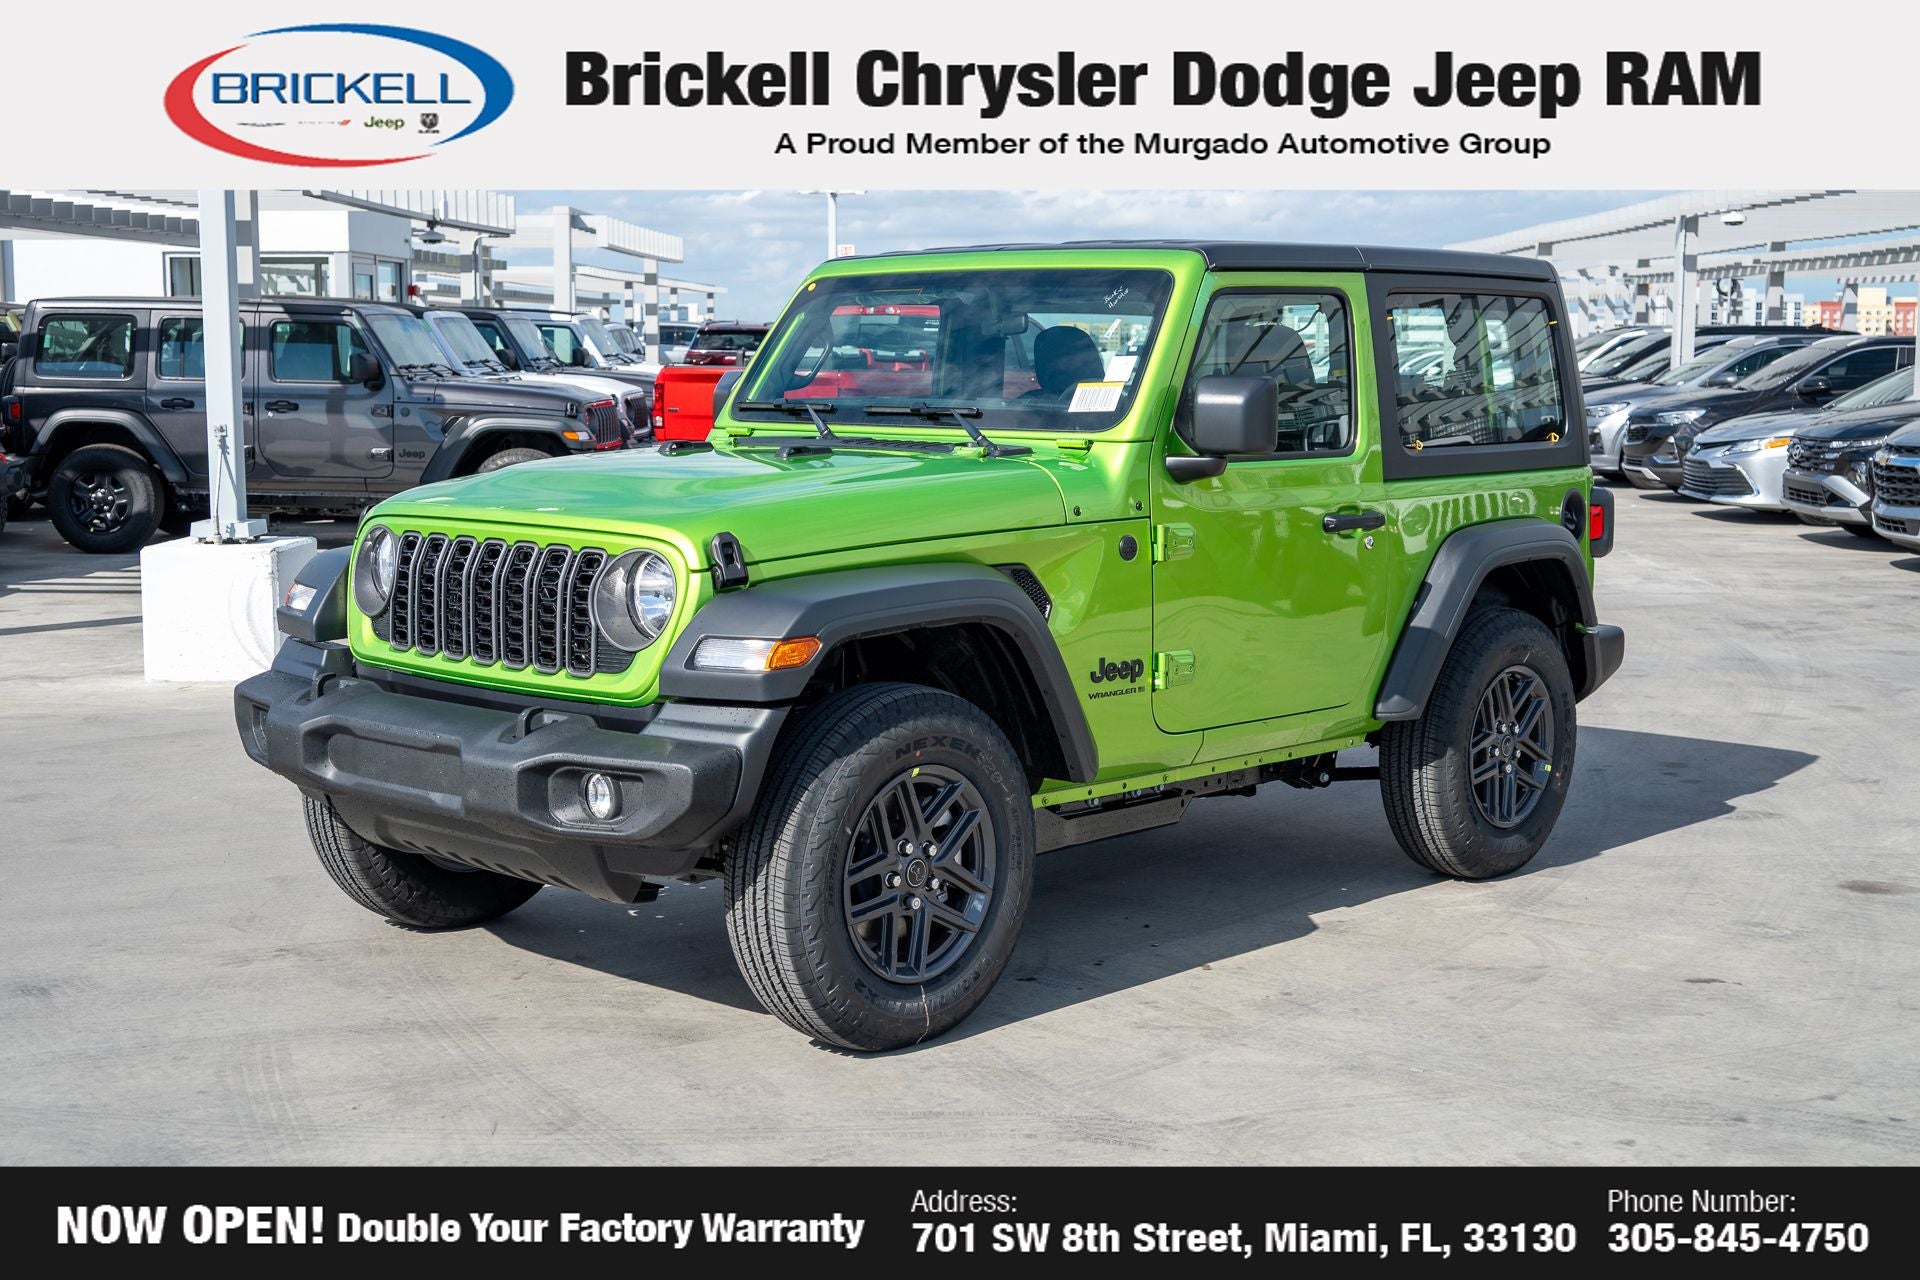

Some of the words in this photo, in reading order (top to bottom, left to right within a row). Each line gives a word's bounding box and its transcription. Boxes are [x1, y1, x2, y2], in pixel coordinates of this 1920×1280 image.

[399, 449, 426, 460] Jeep
[1090, 657, 1144, 683] Jeep
[1088, 686, 1137, 700] WRANGLER
[895, 735, 983, 761] NEXEN
